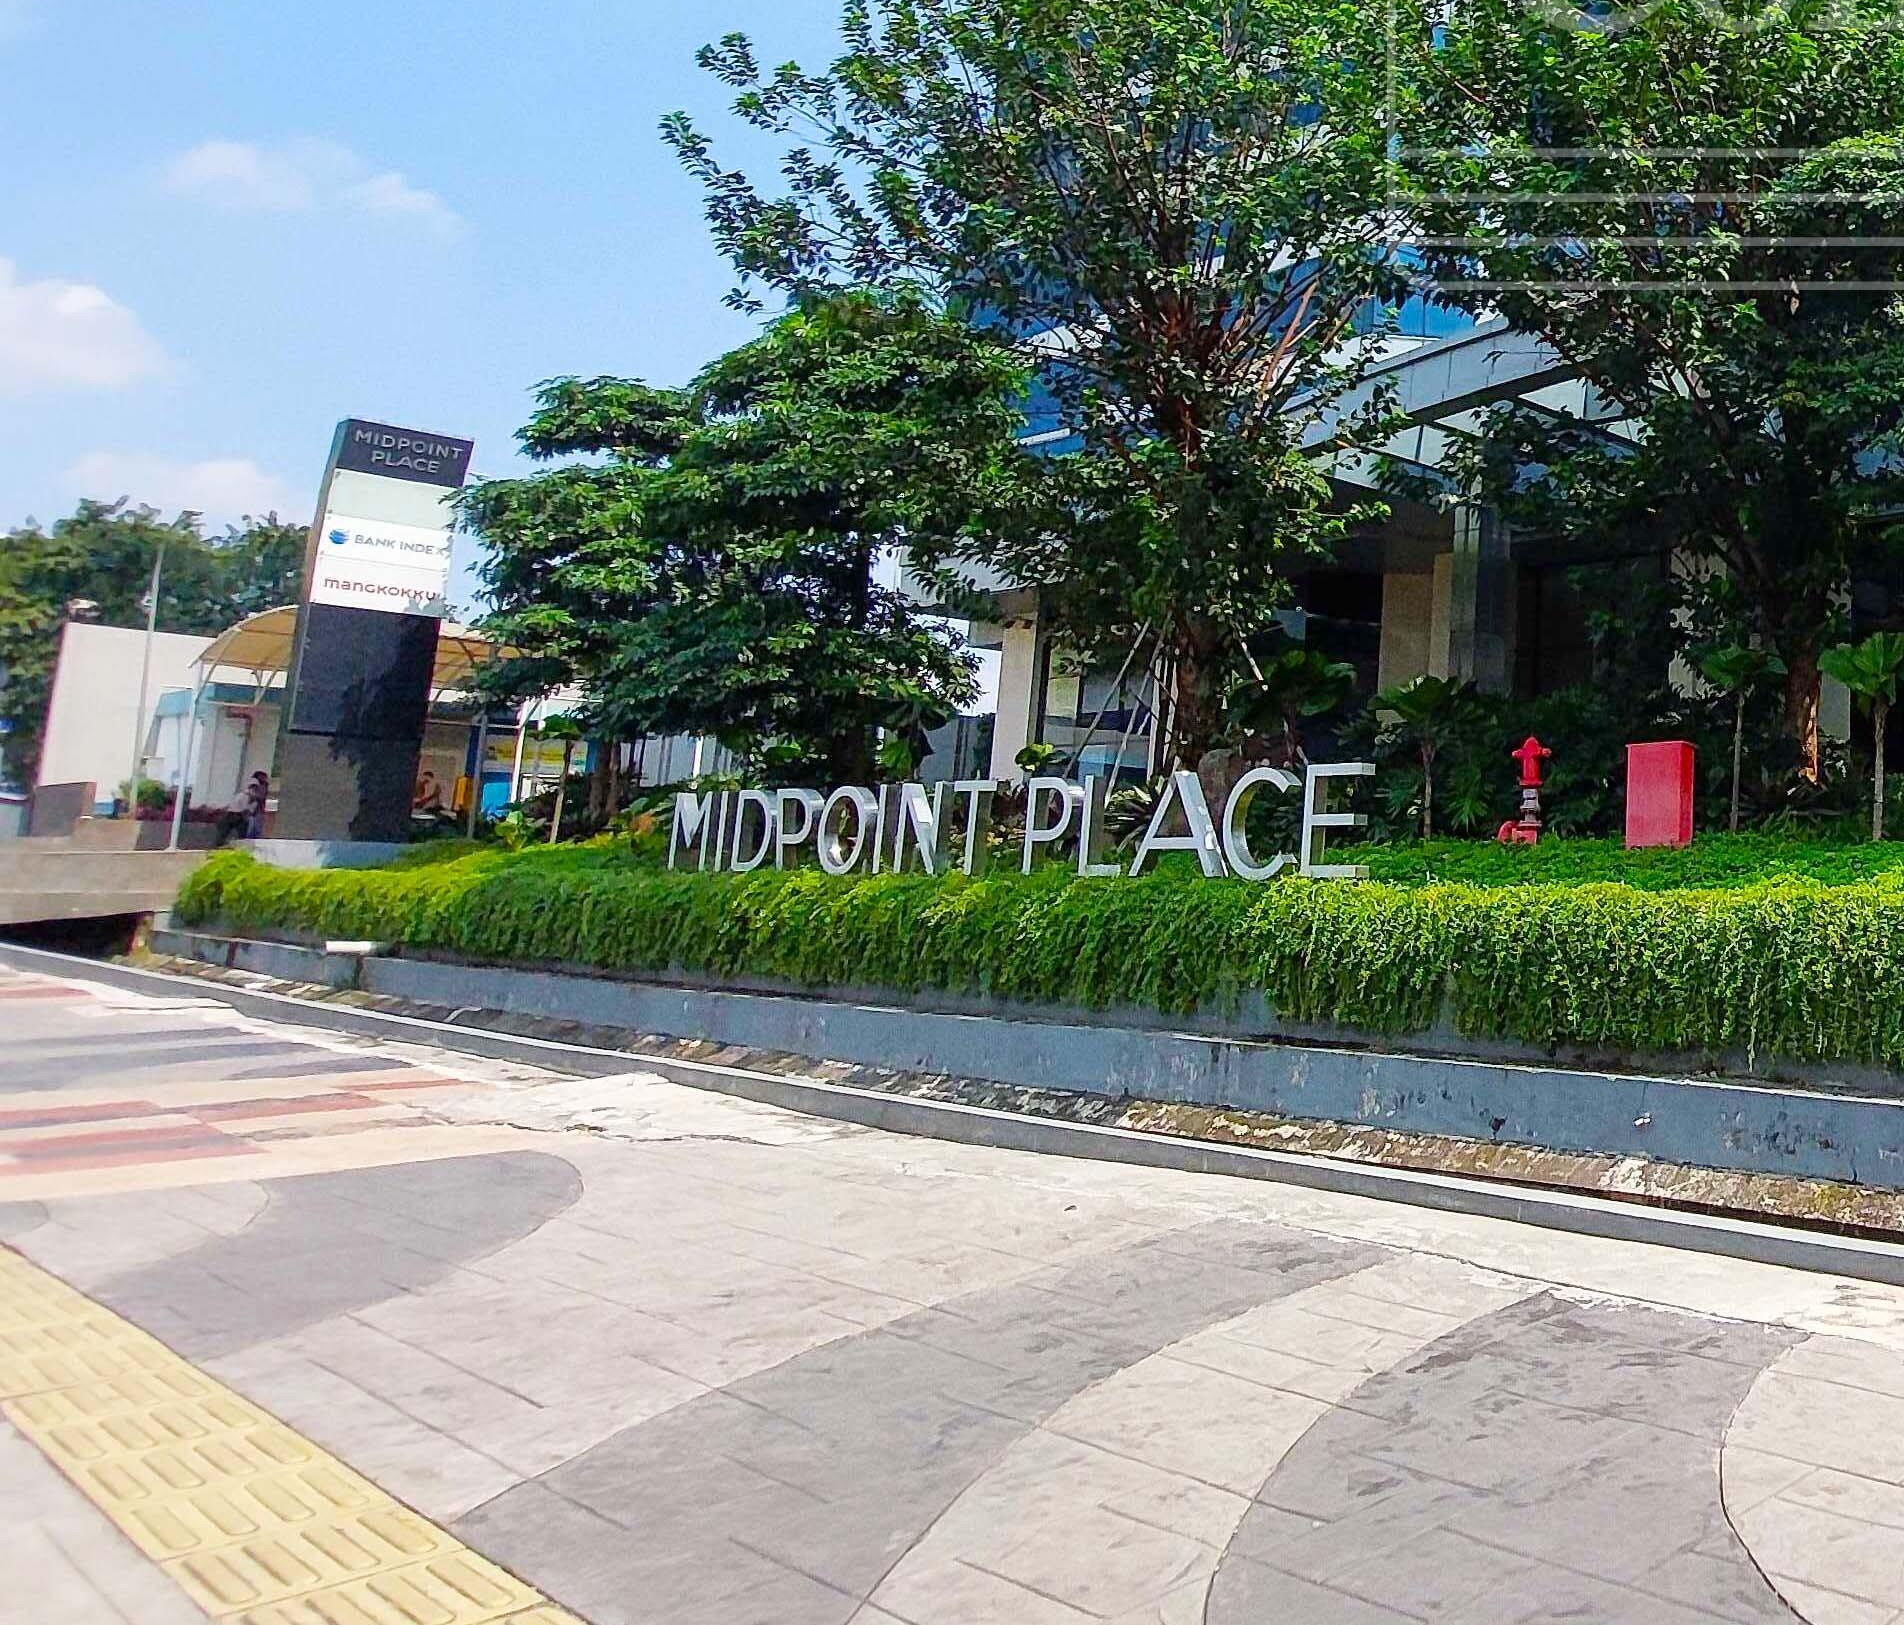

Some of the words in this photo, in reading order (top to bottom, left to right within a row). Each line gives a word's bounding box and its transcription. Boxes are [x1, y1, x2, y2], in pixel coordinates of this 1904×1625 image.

[355, 429, 464, 459] MIDPOINT
[371, 450, 441, 474] PLACE
[355, 534, 396, 549] BANK
[400, 541, 447, 556] INDEX
[668, 780, 1002, 875] MIDPOINT
[1022, 763, 1376, 880] PLACE
